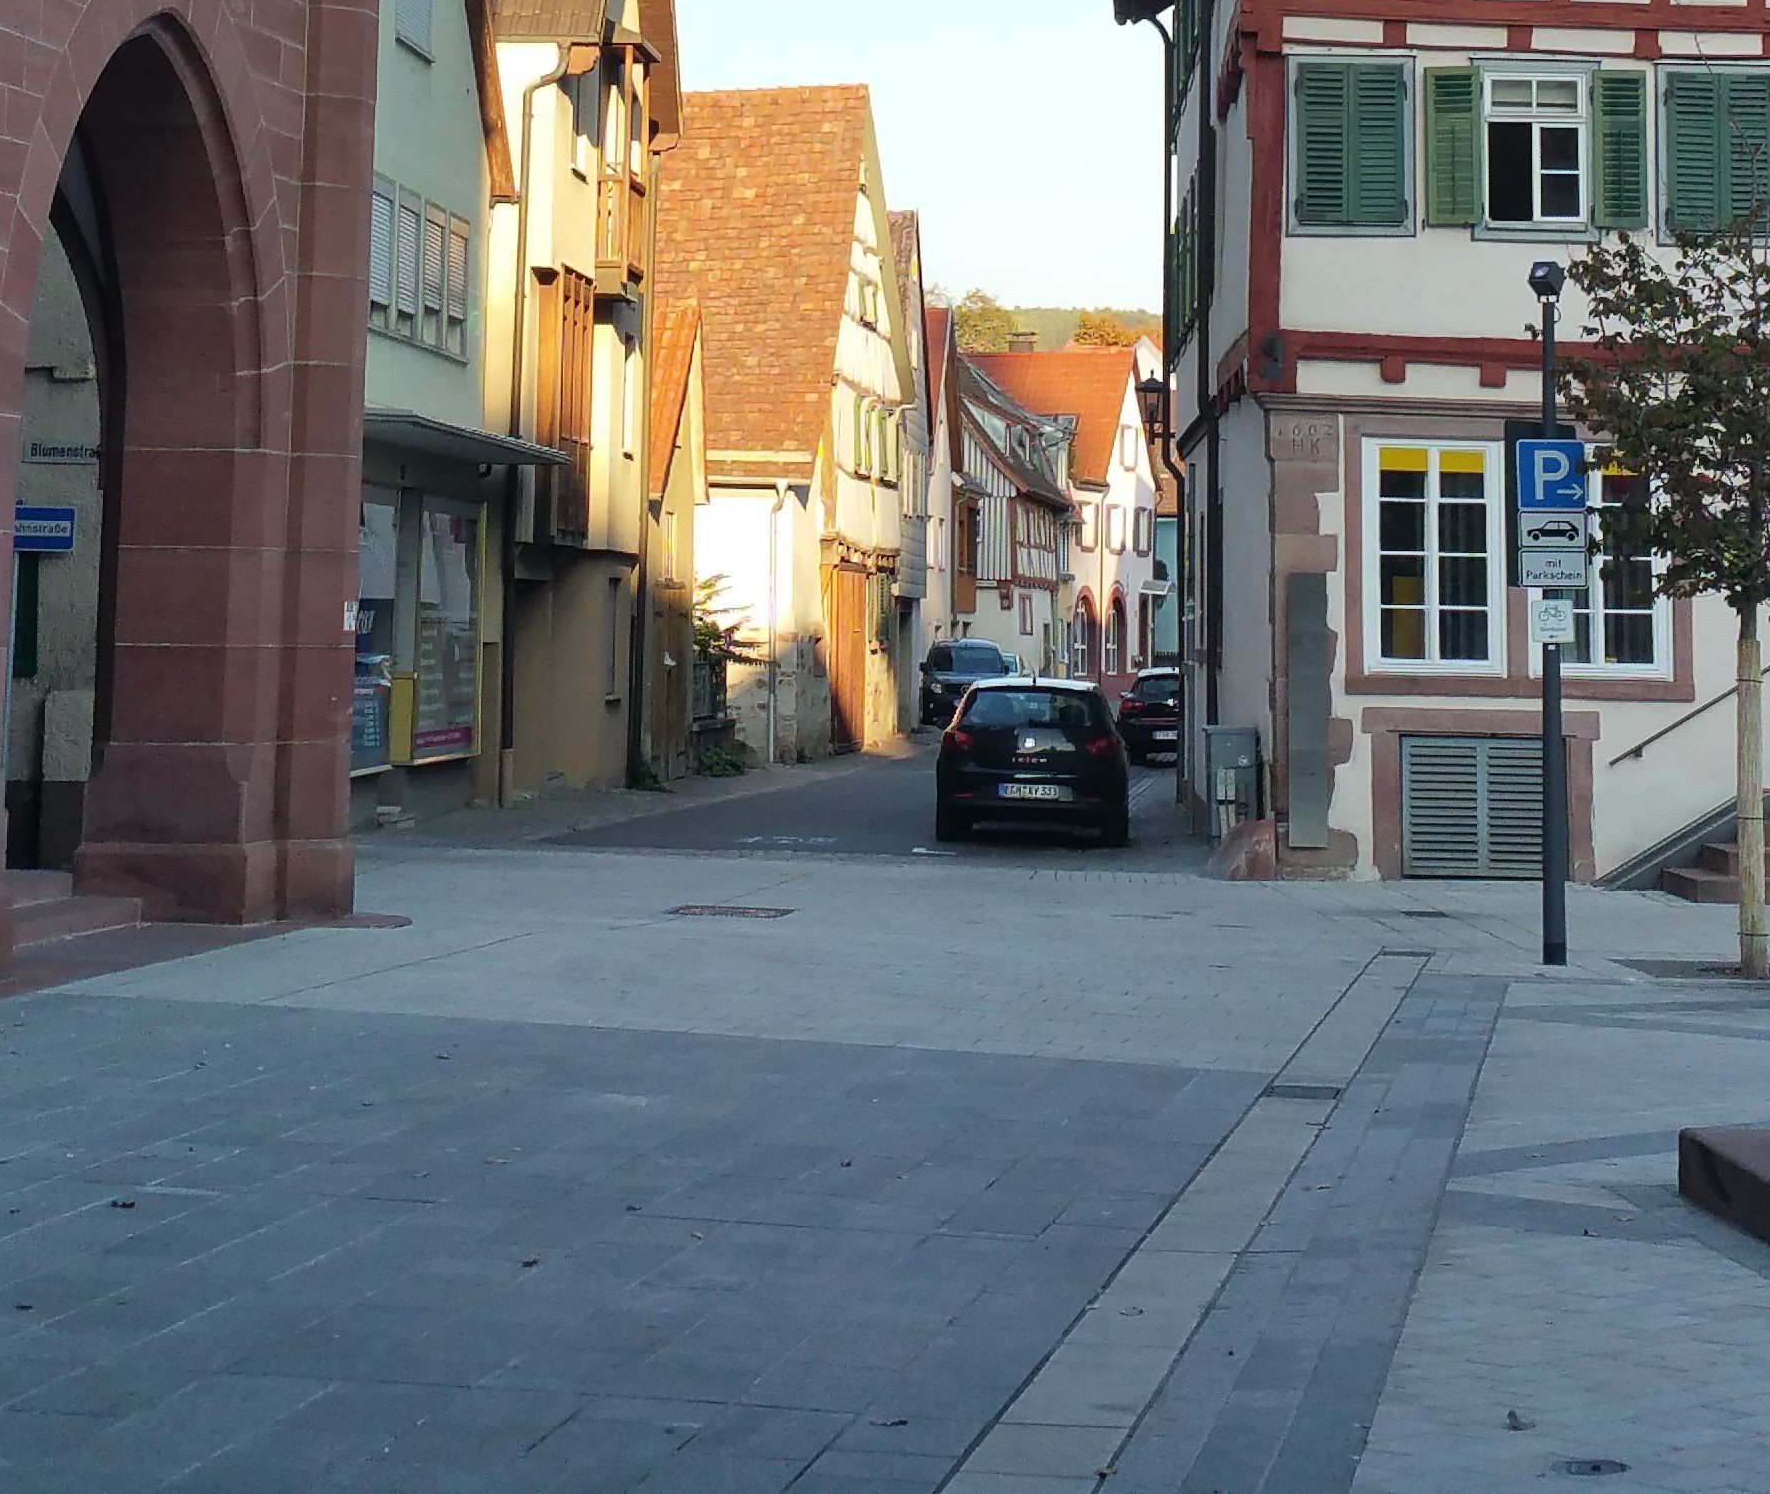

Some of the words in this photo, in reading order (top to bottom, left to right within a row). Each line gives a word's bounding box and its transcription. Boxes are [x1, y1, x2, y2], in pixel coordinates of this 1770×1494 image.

[1534, 449, 1570, 500] P
[1545, 559, 1562, 567] mit
[1526, 570, 1582, 580] Parkschein
